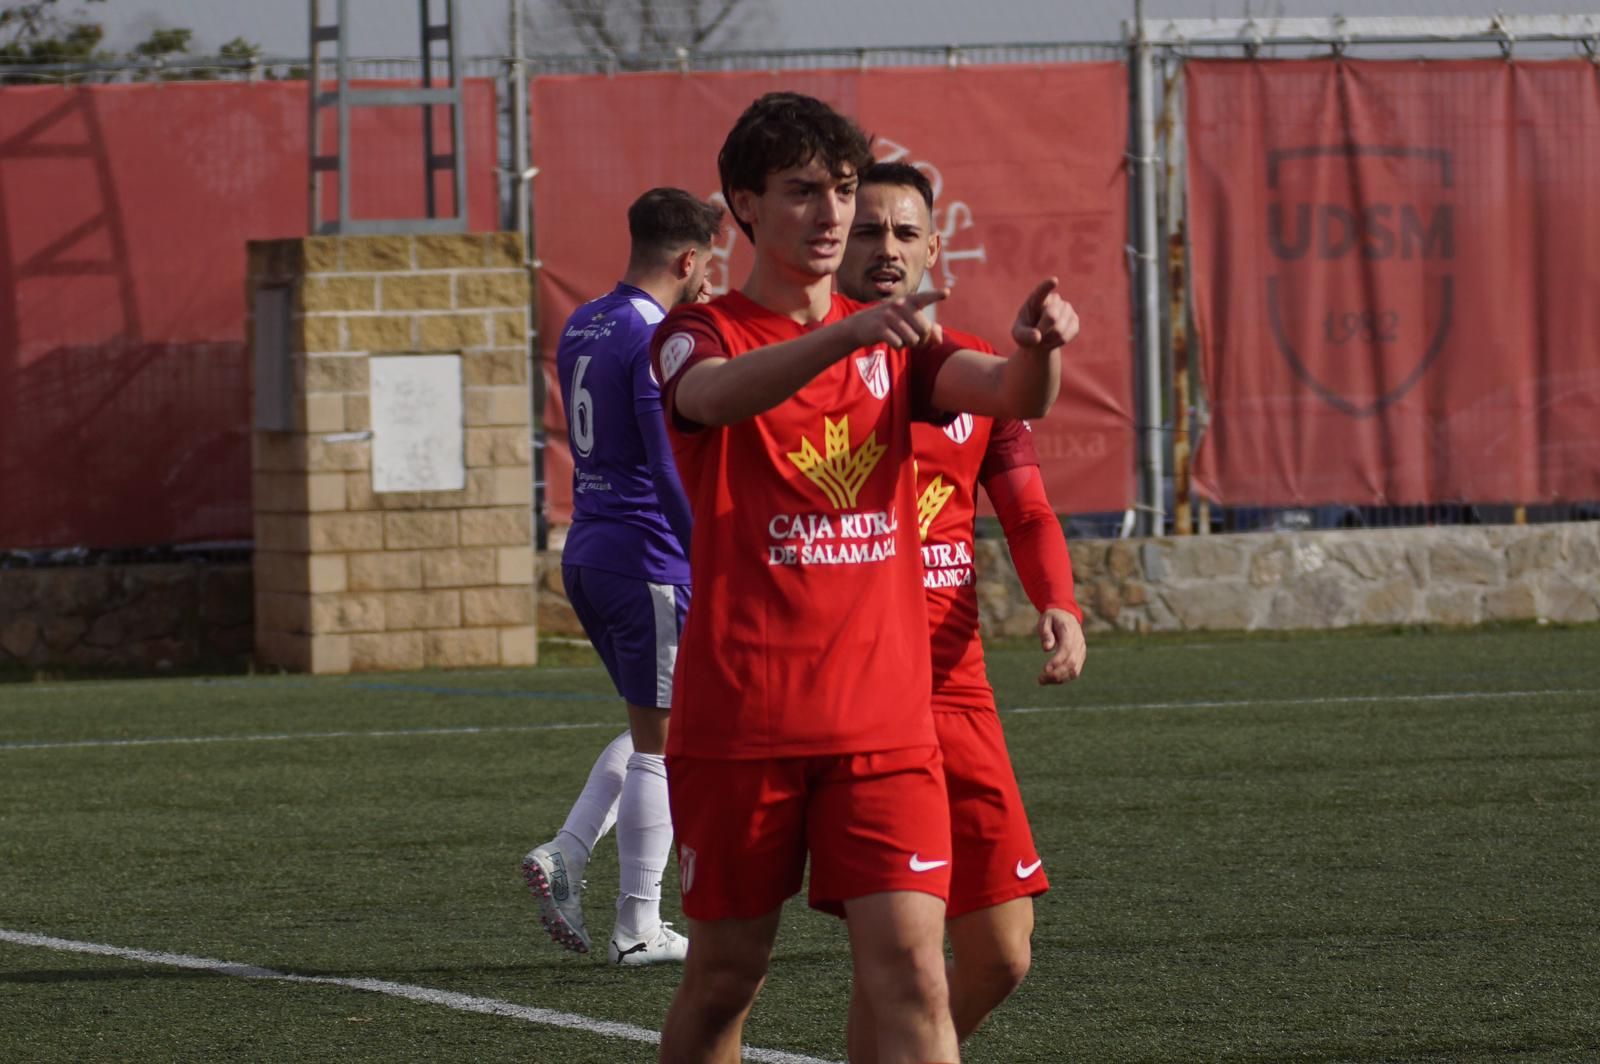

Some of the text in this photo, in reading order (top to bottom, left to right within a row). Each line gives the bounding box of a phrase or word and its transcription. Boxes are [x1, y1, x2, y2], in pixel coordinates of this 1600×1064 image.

[1267, 203, 1456, 260] UDSM
[571, 355, 594, 458] 6
[768, 514, 835, 545] CAJA
[768, 545, 797, 566] DE
[921, 542, 971, 568] URAL
[923, 568, 971, 588] MANCA
